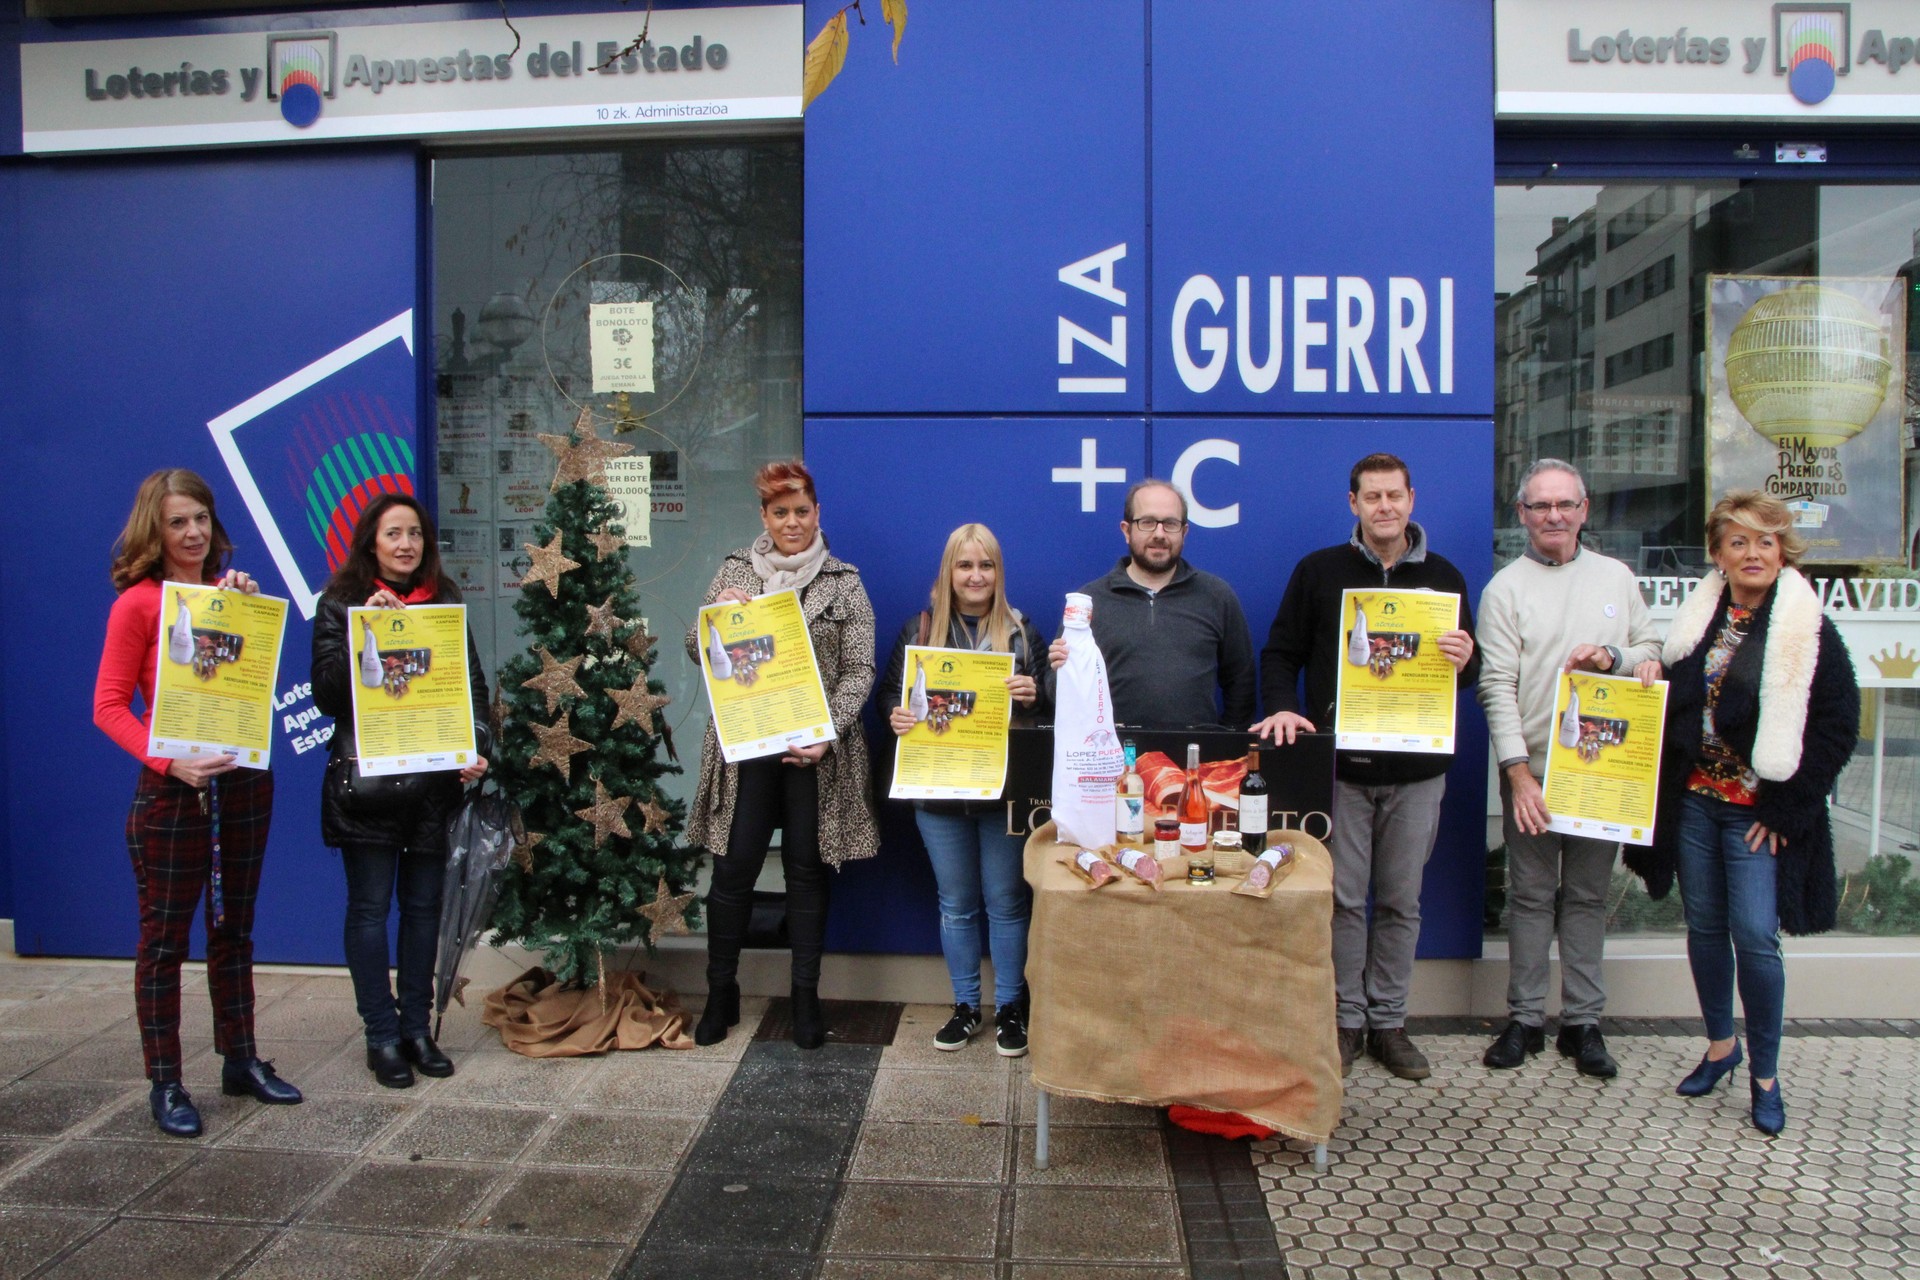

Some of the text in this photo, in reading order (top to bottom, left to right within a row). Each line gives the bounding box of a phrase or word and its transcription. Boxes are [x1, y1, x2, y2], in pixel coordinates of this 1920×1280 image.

[1568, 26, 1730, 64] Loterías
[1743, 36, 1766, 73] y
[84, 36, 728, 101] Loterías y Apuestas del Estado
[596, 102, 728, 120] 10 zk. Administrazioa
[1058, 243, 1126, 393] IZA
[1171, 274, 1453, 394] GUERRI
[614, 358, 632, 369] 3€
[1780, 437, 1791, 449] EL
[605, 461, 644, 470] ARTES
[272, 682, 312, 712] Lote
